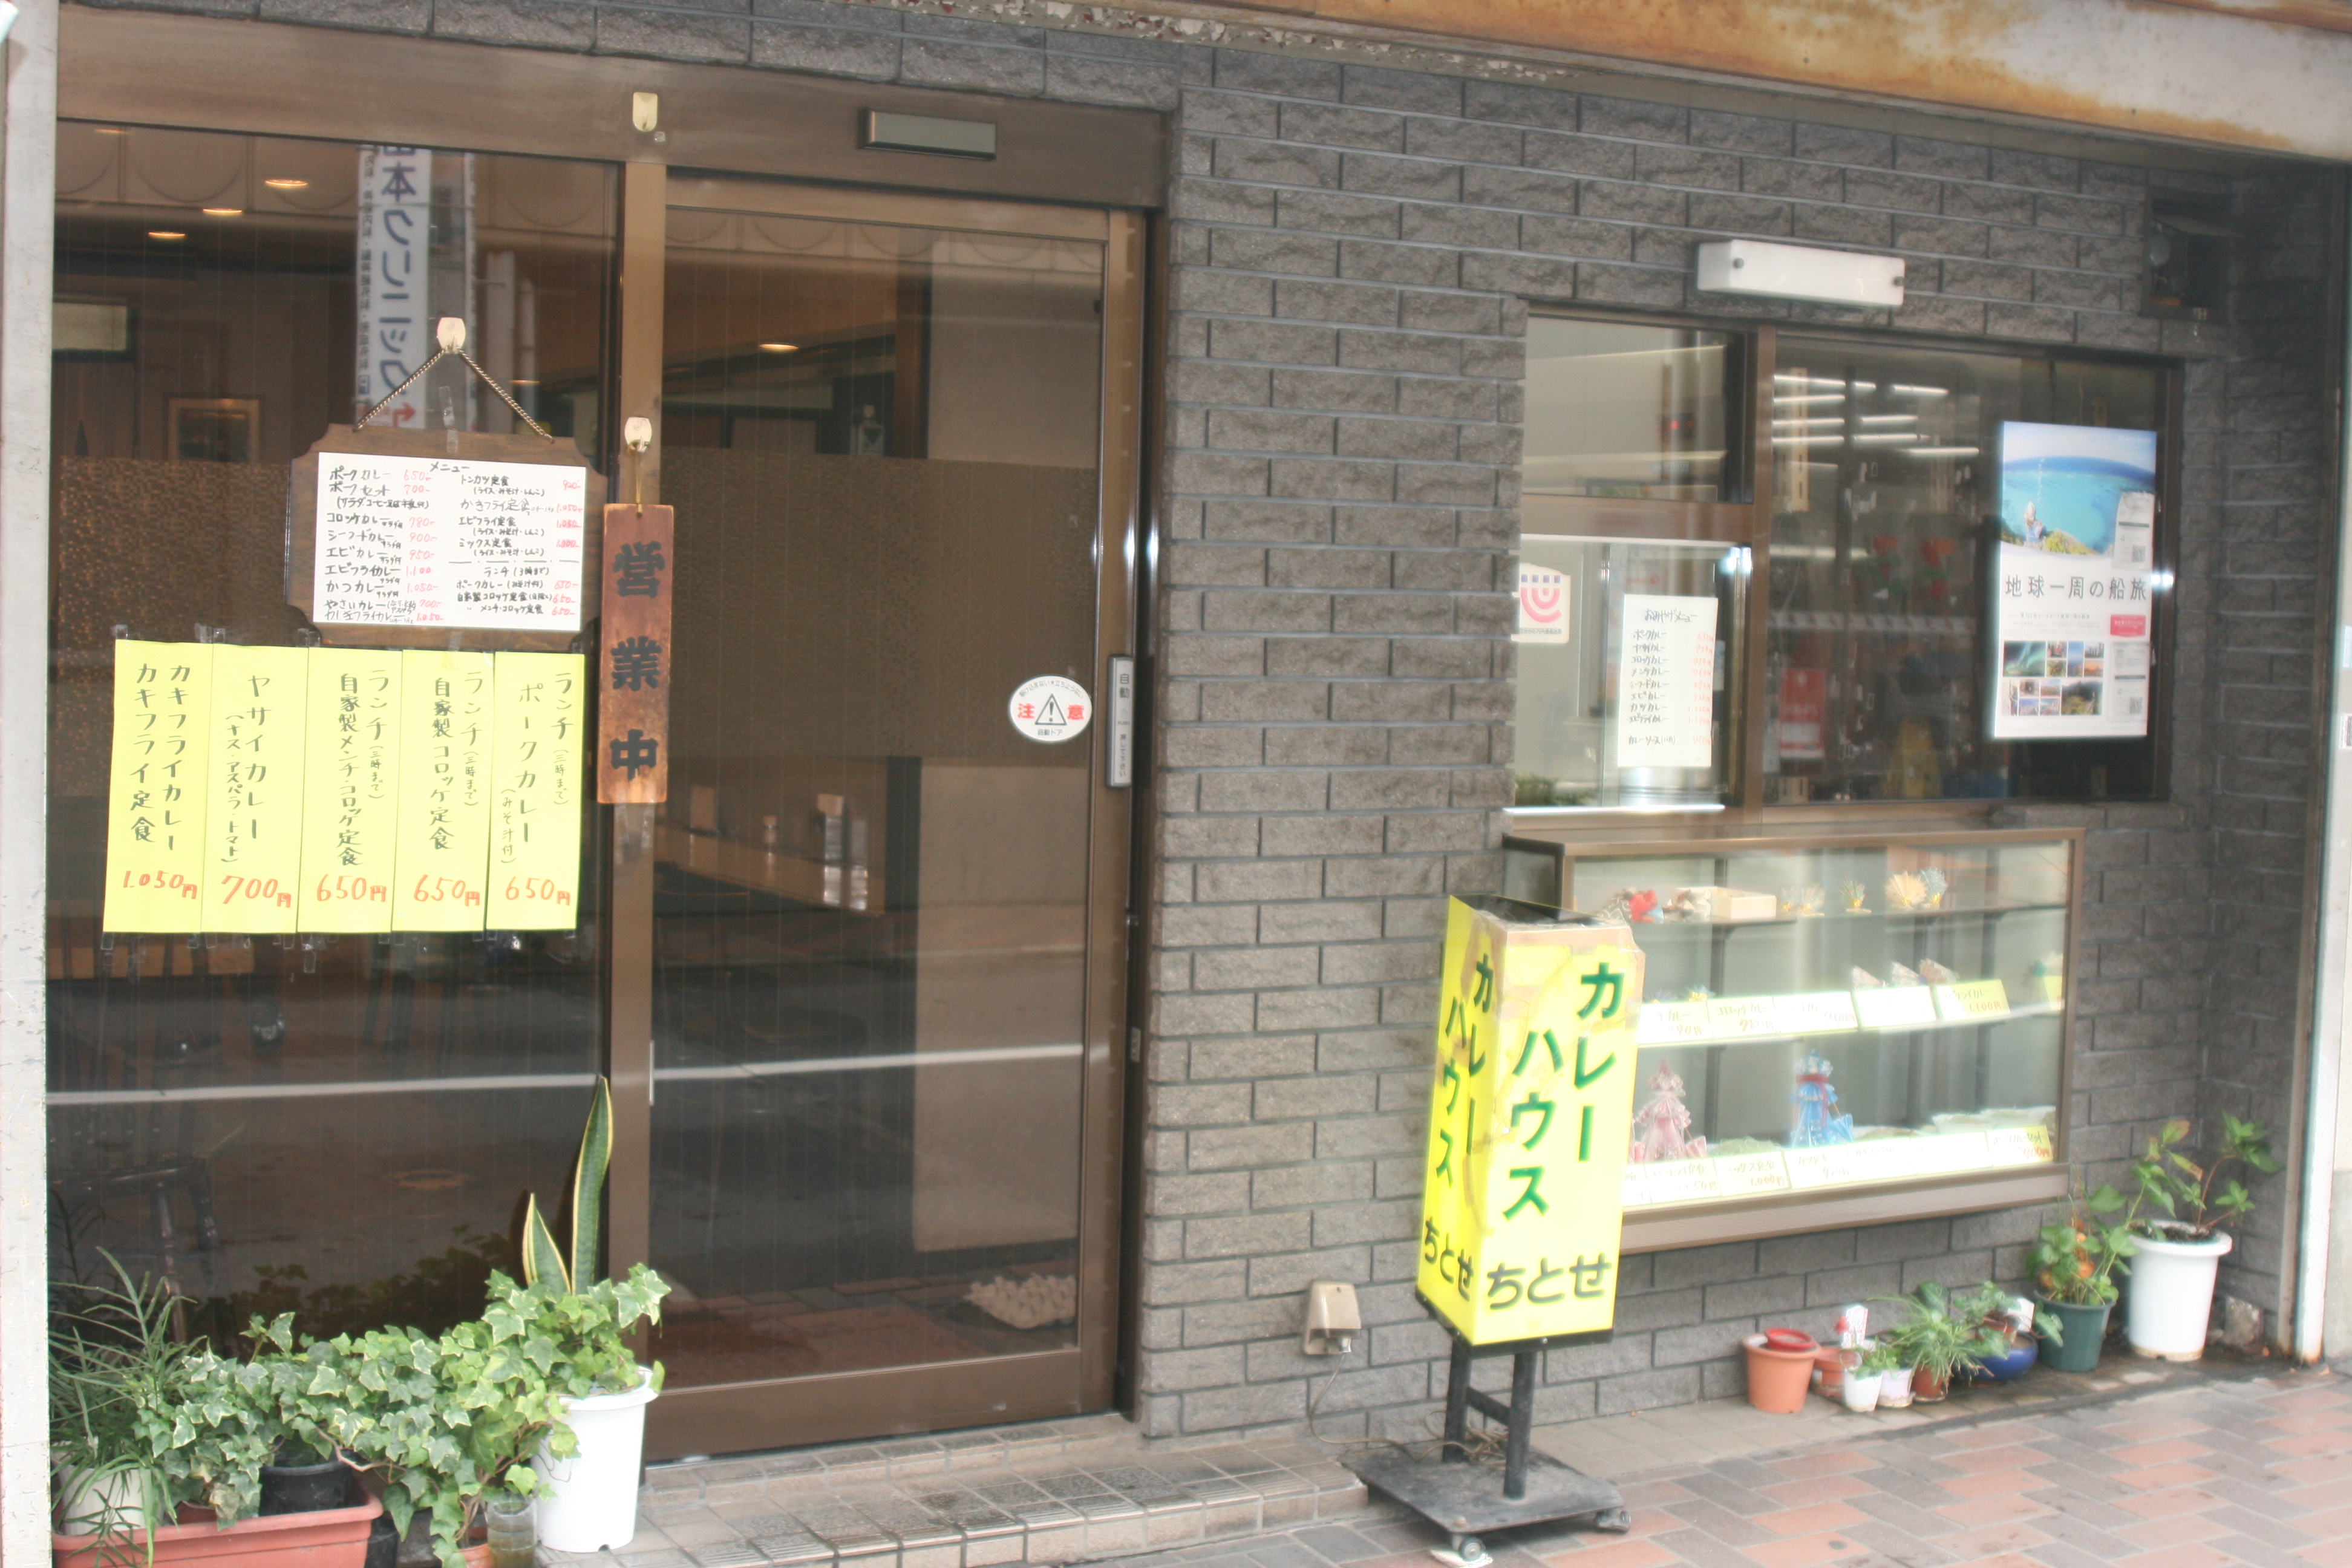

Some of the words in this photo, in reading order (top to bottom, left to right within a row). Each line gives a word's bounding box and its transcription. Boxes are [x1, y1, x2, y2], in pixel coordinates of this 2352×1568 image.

[430, 461, 470, 472] メニュー
[461, 474, 509, 486] トンカツ定食
[327, 513, 391, 524] コロッケカレー
[459, 515, 516, 527] エビフライ定食
[327, 528, 394, 541] シーフードカレー
[459, 537, 512, 549] ミックス定食
[325, 545, 388, 558] エビカレー
[324, 562, 401, 577] エビフライカレー
[326, 580, 384, 593] かつカレー
[2004, 573, 2148, 602] 地球一周の船旅
[324, 599, 387, 610] やさいカレー
[1633, 629, 1667, 641] ポークカレー
[610, 540, 665, 782] 営業中
[1119, 673, 1129, 698] 自動
[1631, 691, 1666, 701] エビカレー
[1630, 702, 1668, 713] カツカレー
[129, 663, 157, 843] カキフライ定食
[162, 665, 191, 851] カキフライカレー
[245, 675, 272, 840] ヤサイカレー
[430, 677, 455, 850] 自家製コロッケ定食
[515, 682, 544, 843] ポークカレー
[221, 875, 292, 908] 700円
[316, 874, 387, 903] 650円
[413, 874, 480, 907] 650円
[505, 875, 570, 906] 650円
[1717, 1003, 1768, 1017] コロッケカレー
[1465, 953, 1494, 1156] カレー
[1574, 962, 1625, 1163] カレー
[1436, 995, 1469, 1188] ハウス
[1502, 1027, 1566, 1221] ハウス
[1423, 1216, 1475, 1302] ちとせ
[1486, 1253, 1613, 1311] ちとせ
